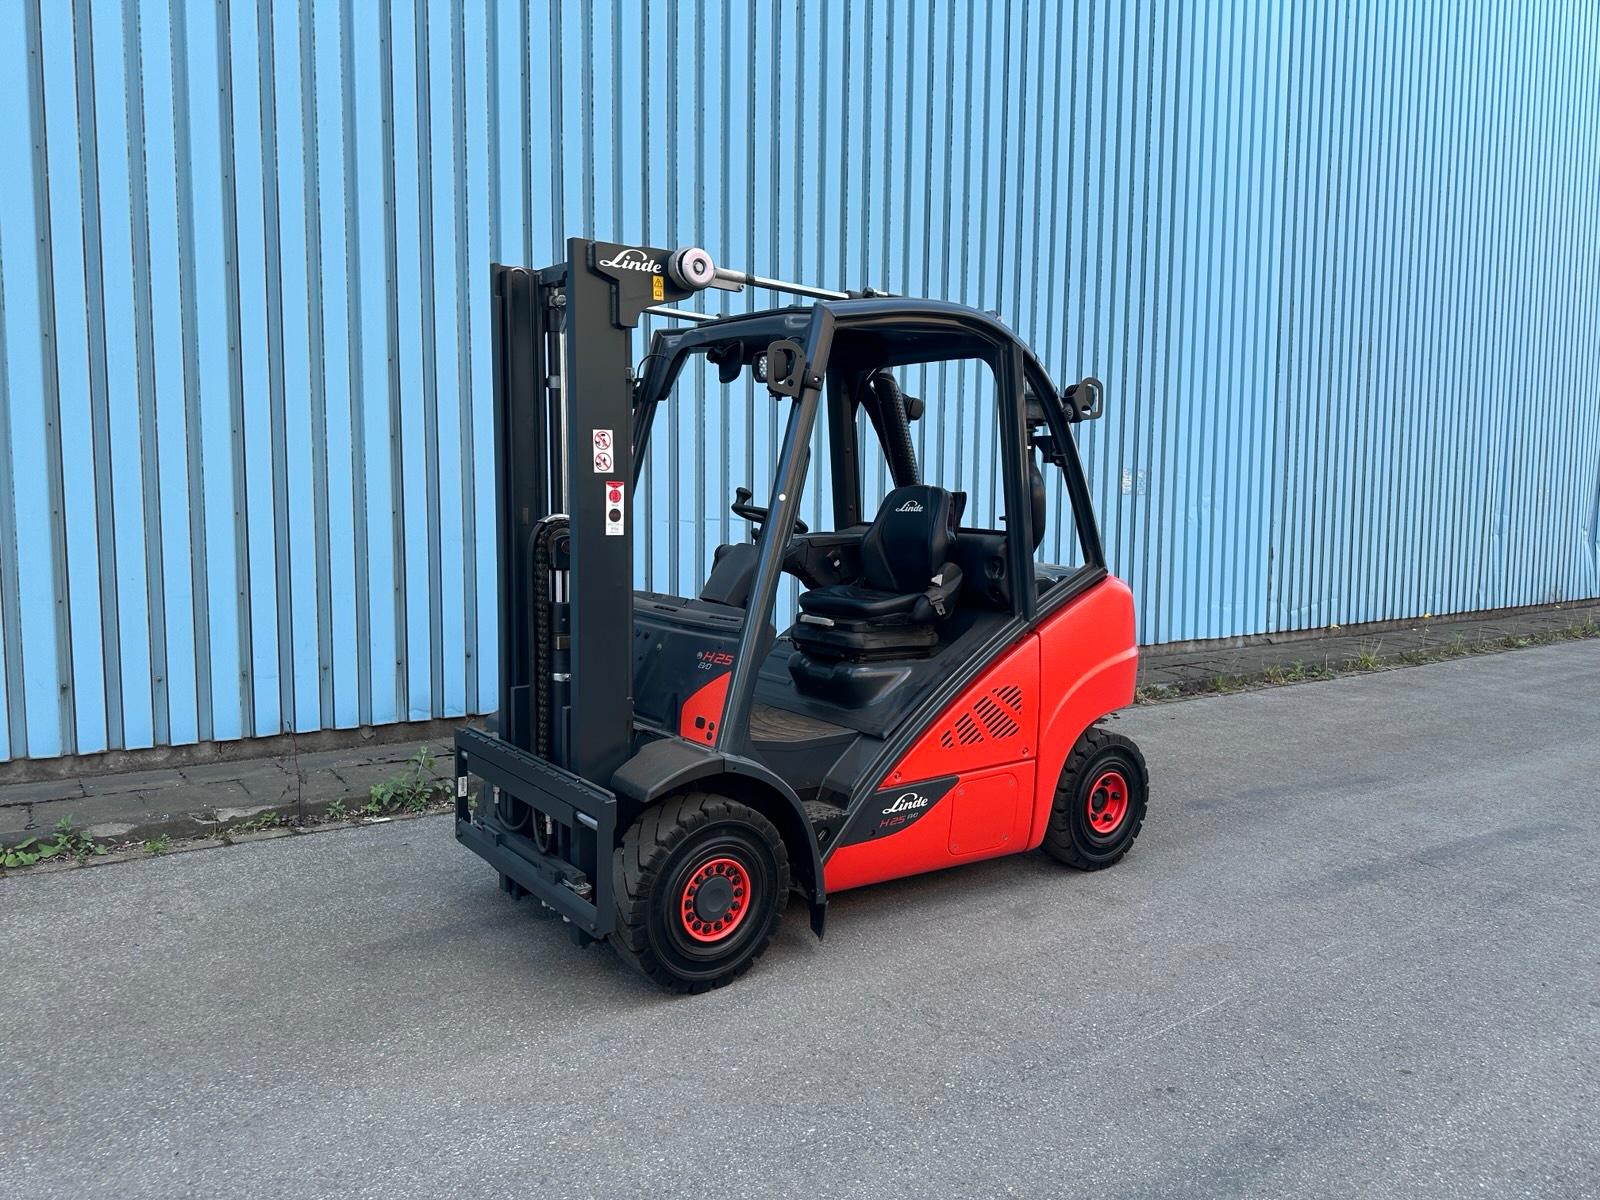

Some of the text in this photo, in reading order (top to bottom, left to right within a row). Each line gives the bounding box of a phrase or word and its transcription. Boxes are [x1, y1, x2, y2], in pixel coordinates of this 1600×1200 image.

[600, 249, 662, 273] Linde
[895, 500, 923, 512] Linde
[882, 792, 928, 814] Linde
